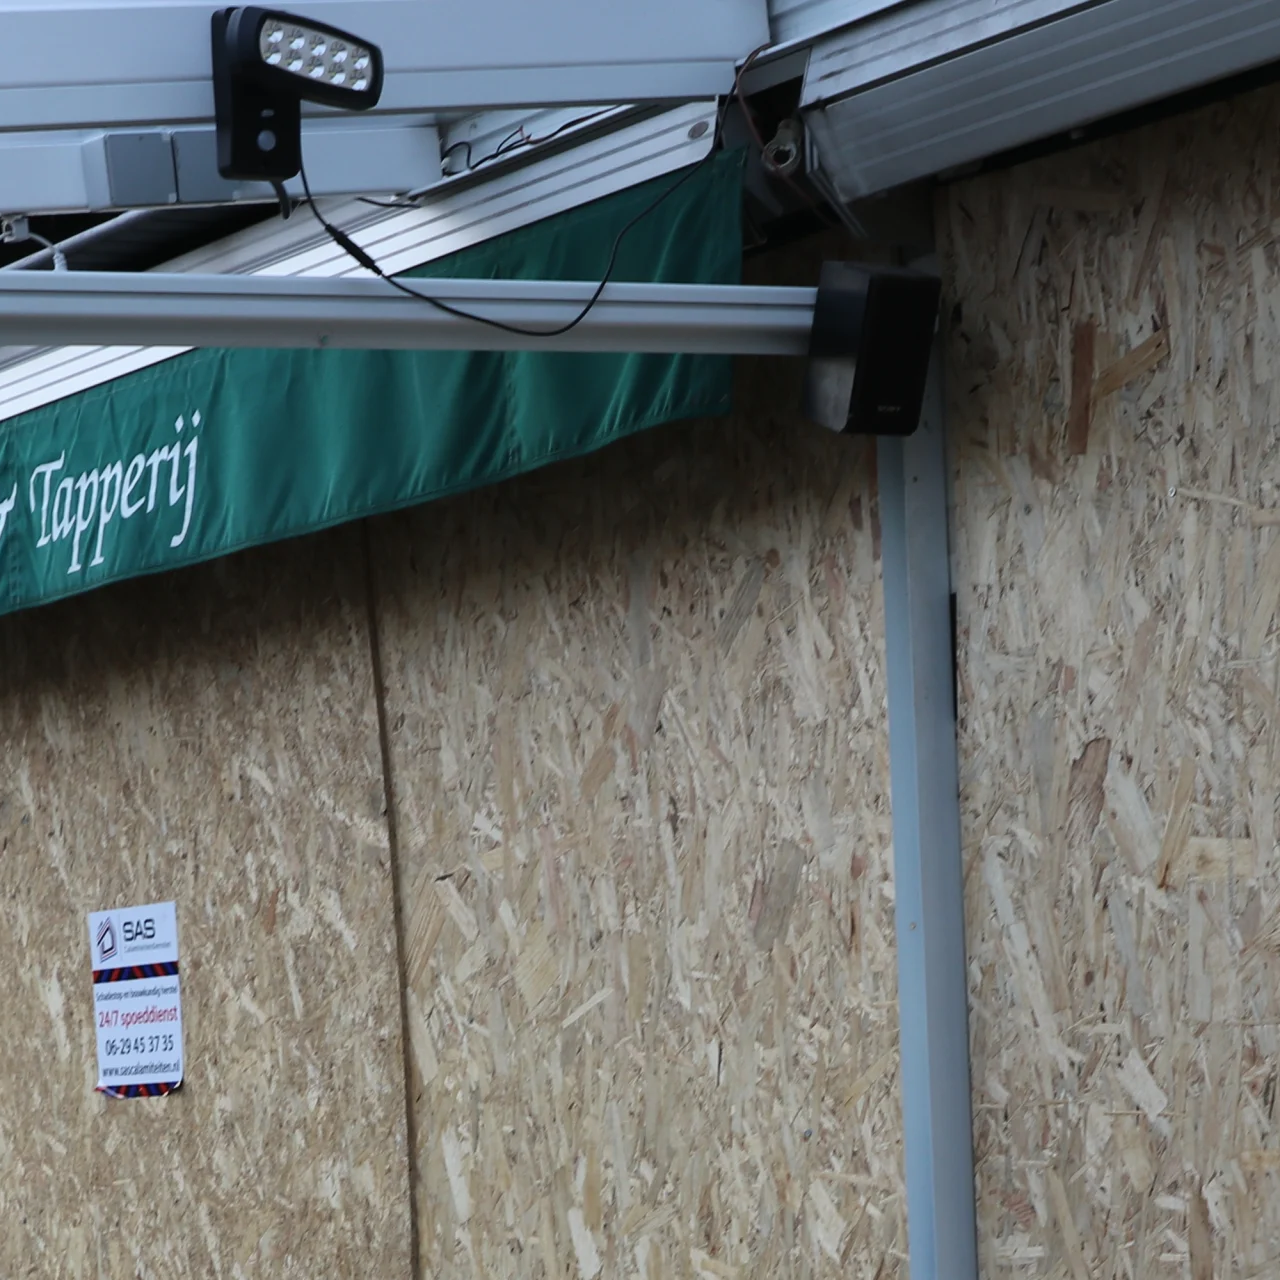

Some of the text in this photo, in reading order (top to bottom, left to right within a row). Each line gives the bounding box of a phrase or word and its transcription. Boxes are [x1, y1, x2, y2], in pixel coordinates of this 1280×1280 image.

[28, 408, 202, 575] Tapperij
[122, 918, 156, 942] SAS
[99, 1005, 178, 1030] 24/7 spoeddienst
